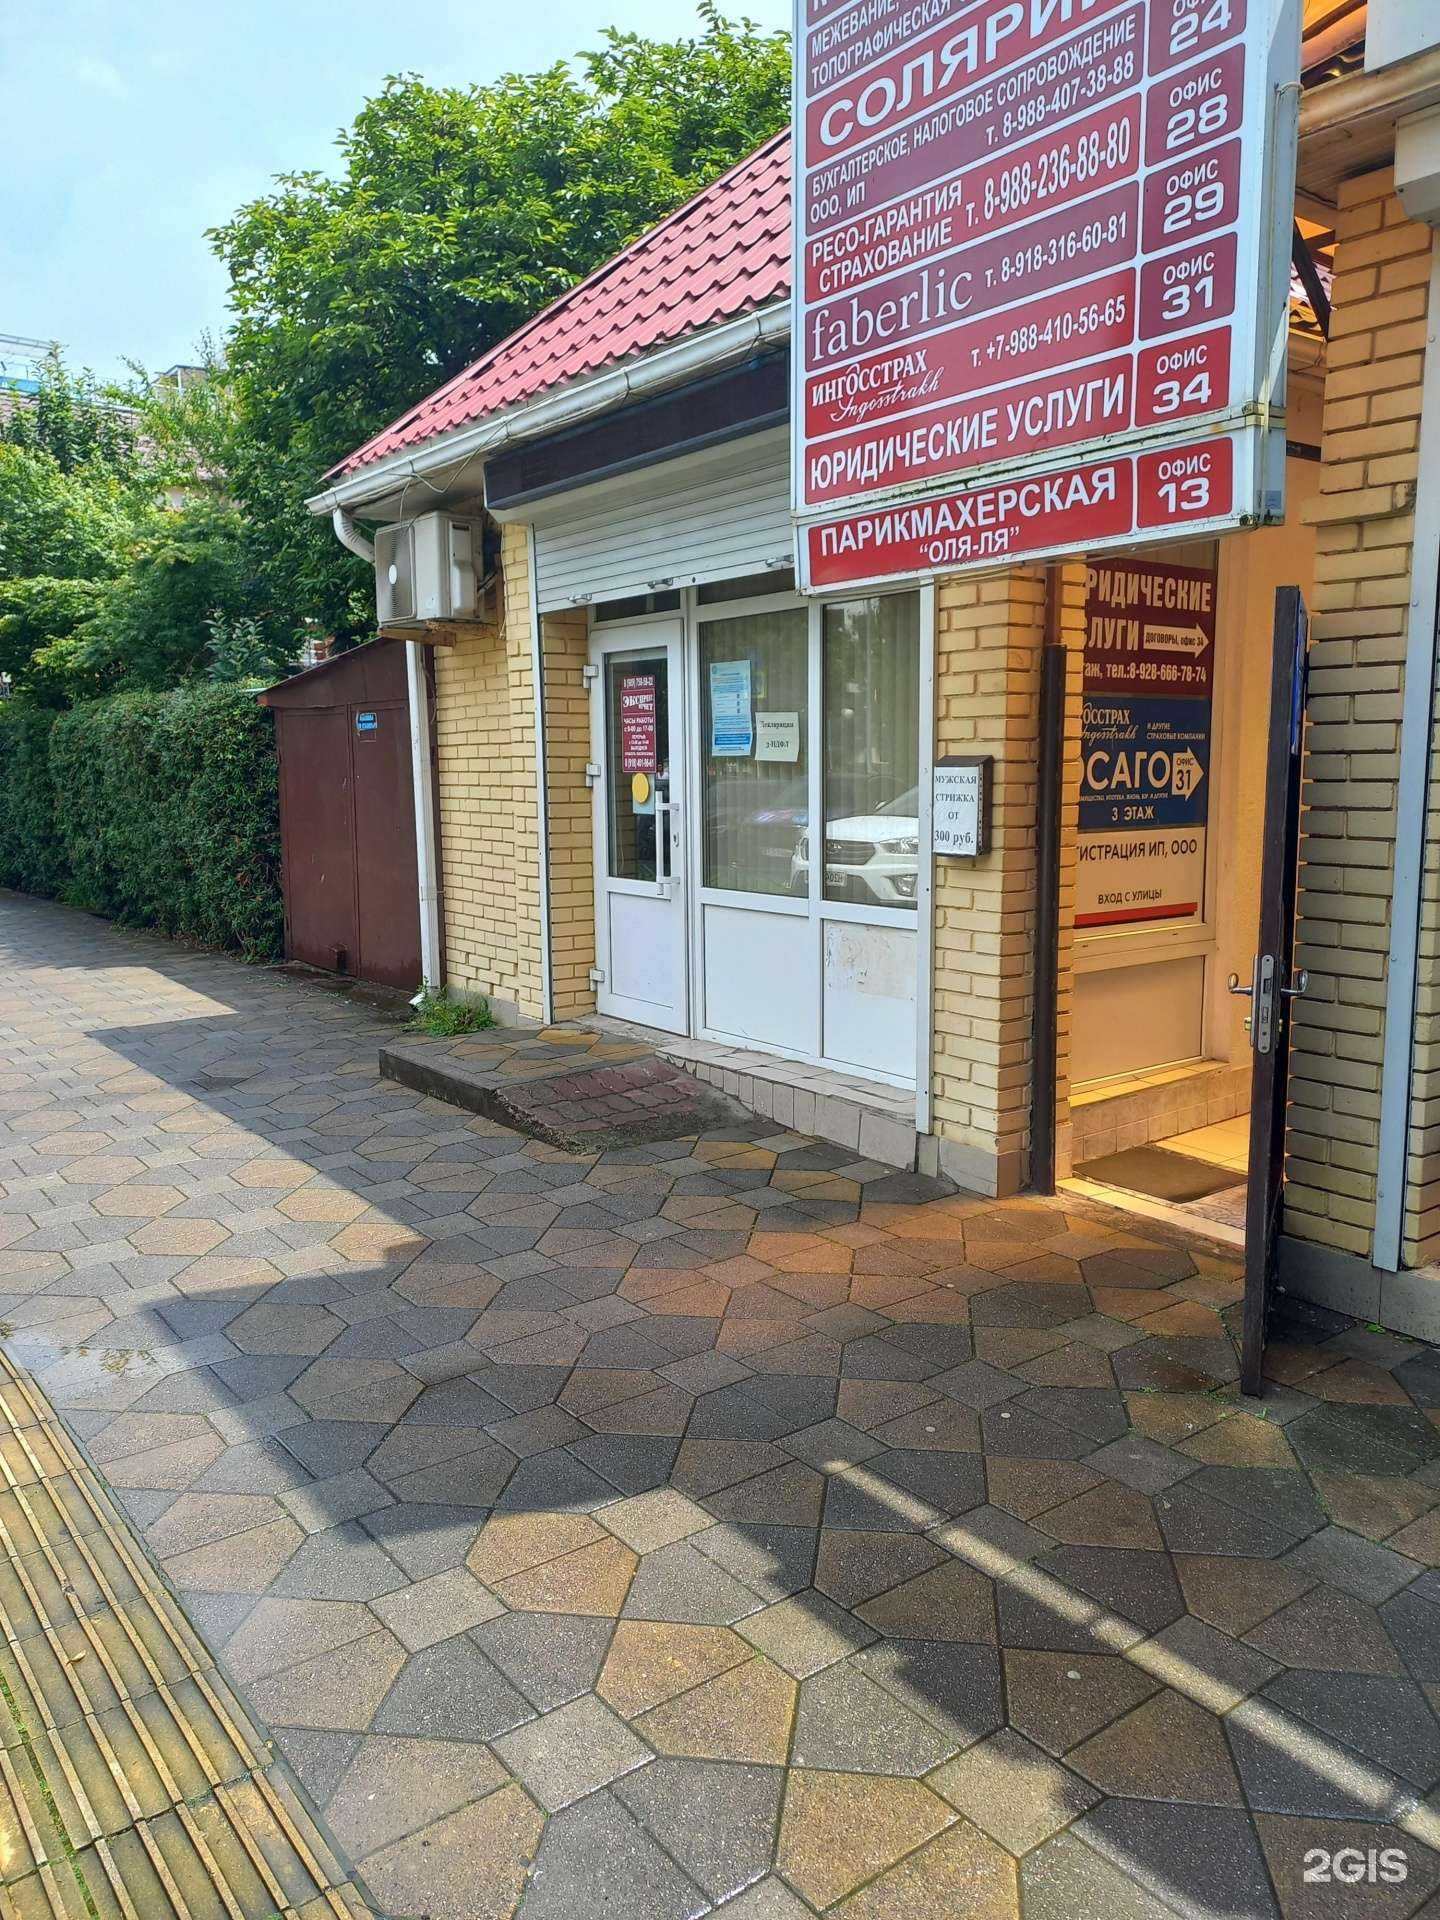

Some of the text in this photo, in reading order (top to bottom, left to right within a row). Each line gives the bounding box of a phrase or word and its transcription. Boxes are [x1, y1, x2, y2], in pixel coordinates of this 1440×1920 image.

[812, 0, 950, 89] ТОПОГРАФИЧЕСКАЯ
[1170, 0, 1232, 55] 24
[820, 0, 1097, 146] СОЛЯРИ
[1169, 67, 1222, 108] ОФИС
[812, 13, 1136, 197] БУХГАЛТЕРСКОЕ, НАЛОГОВОЕ СОПРОВОЖДЕНИЕ
[985, 50, 1134, 146] т. 8-988-407-38-88
[1166, 93, 1228, 150] 28
[966, 116, 1130, 228] т. 8-988-236-88-80
[1166, 158, 1219, 196] ОФИС
[810, 181, 866, 224] ООО, ИП
[812, 179, 962, 267] РЕСО-ГАРАНТИЯ
[1163, 181, 1225, 235] 29
[819, 217, 952, 293] СТРАХОВАНИЕ
[985, 211, 1127, 288] т. 8-918-316-60-81
[1163, 251, 1215, 285] ОФИС
[812, 268, 973, 362] faberlic
[1162, 275, 1213, 320] 31
[971, 294, 1125, 368] т. +7-988-410-56-65
[812, 349, 928, 407] ИНГОССТРАХ
[1156, 344, 1208, 375] ОФИС
[830, 366, 945, 423] Ingosstrakh
[1152, 371, 1212, 415] 34
[811, 373, 1125, 491] ЮРИДИЧЕСКИЕ УСЛУГИ
[1158, 453, 1212, 480] ОФИС
[821, 466, 1116, 557] ПАРИКМАХЕРСКАЯ
[1157, 477, 1210, 513] 13
[1086, 567, 1212, 612] РИДИЧЕСКИЕ
[1087, 616, 1140, 651] ЛУГИ
[1083, 702, 1131, 725] ОССТРАХ
[935, 775, 977, 785] МУЖСКАЯ
[1080, 750, 1171, 790] САГО
[1176, 769, 1191, 791] 31
[935, 793, 975, 803] СТРИЖКА
[948, 811, 960, 820] ОТ
[1112, 805, 1155, 821] 3 ЭТАЖ
[934, 830, 974, 846] 300 руб.
[1079, 842, 1145, 861] ИСТРАЦИЯ
[1171, 838, 1198, 855] ООО
[1098, 892, 1122, 904] ВХОД
[1131, 889, 1162, 902] УЛИЦЫ
